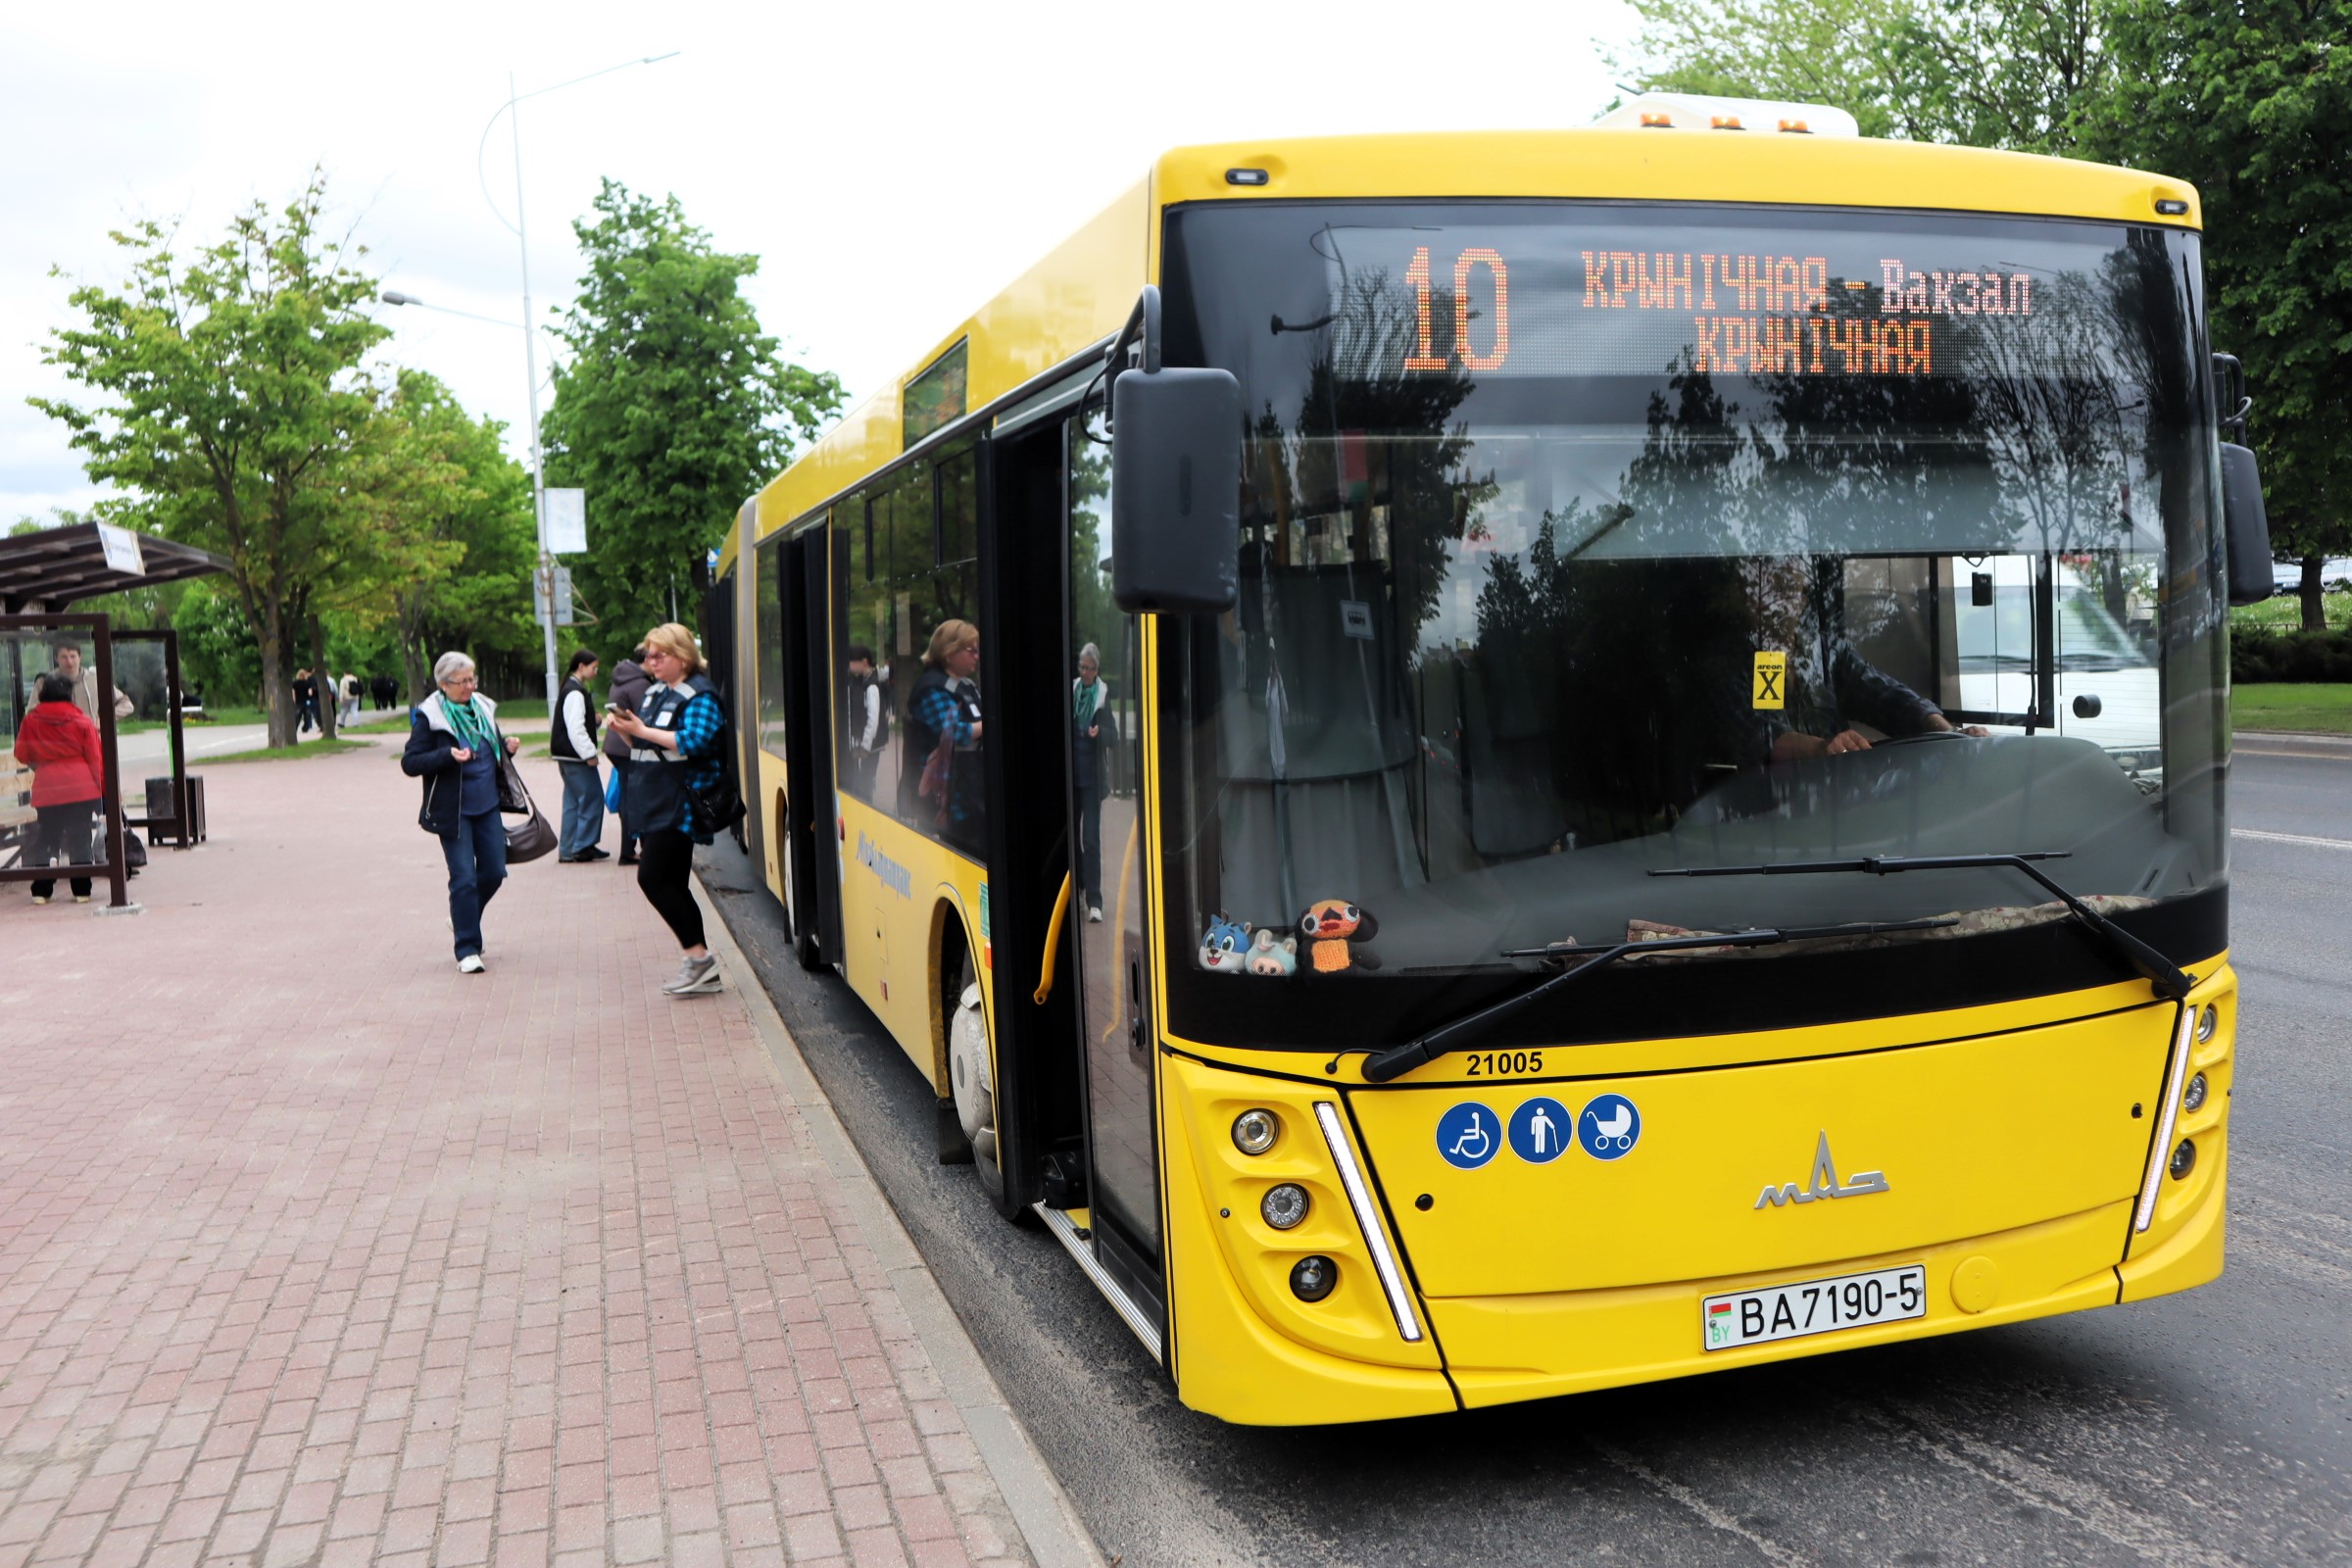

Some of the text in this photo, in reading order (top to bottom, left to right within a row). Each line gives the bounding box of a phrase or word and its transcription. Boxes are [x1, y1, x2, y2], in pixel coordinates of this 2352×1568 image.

[1581, 250, 1827, 312] КРЫНІЧНАЯ
[1880, 259, 2031, 317] Вакзал
[1403, 246, 1508, 370] 10
[1694, 316, 1932, 374] КРЫНІЧНАЯ
[1756, 670, 1782, 700] X
[1466, 1052, 1543, 1075] 21005
[1711, 1325, 1731, 1344] BY
